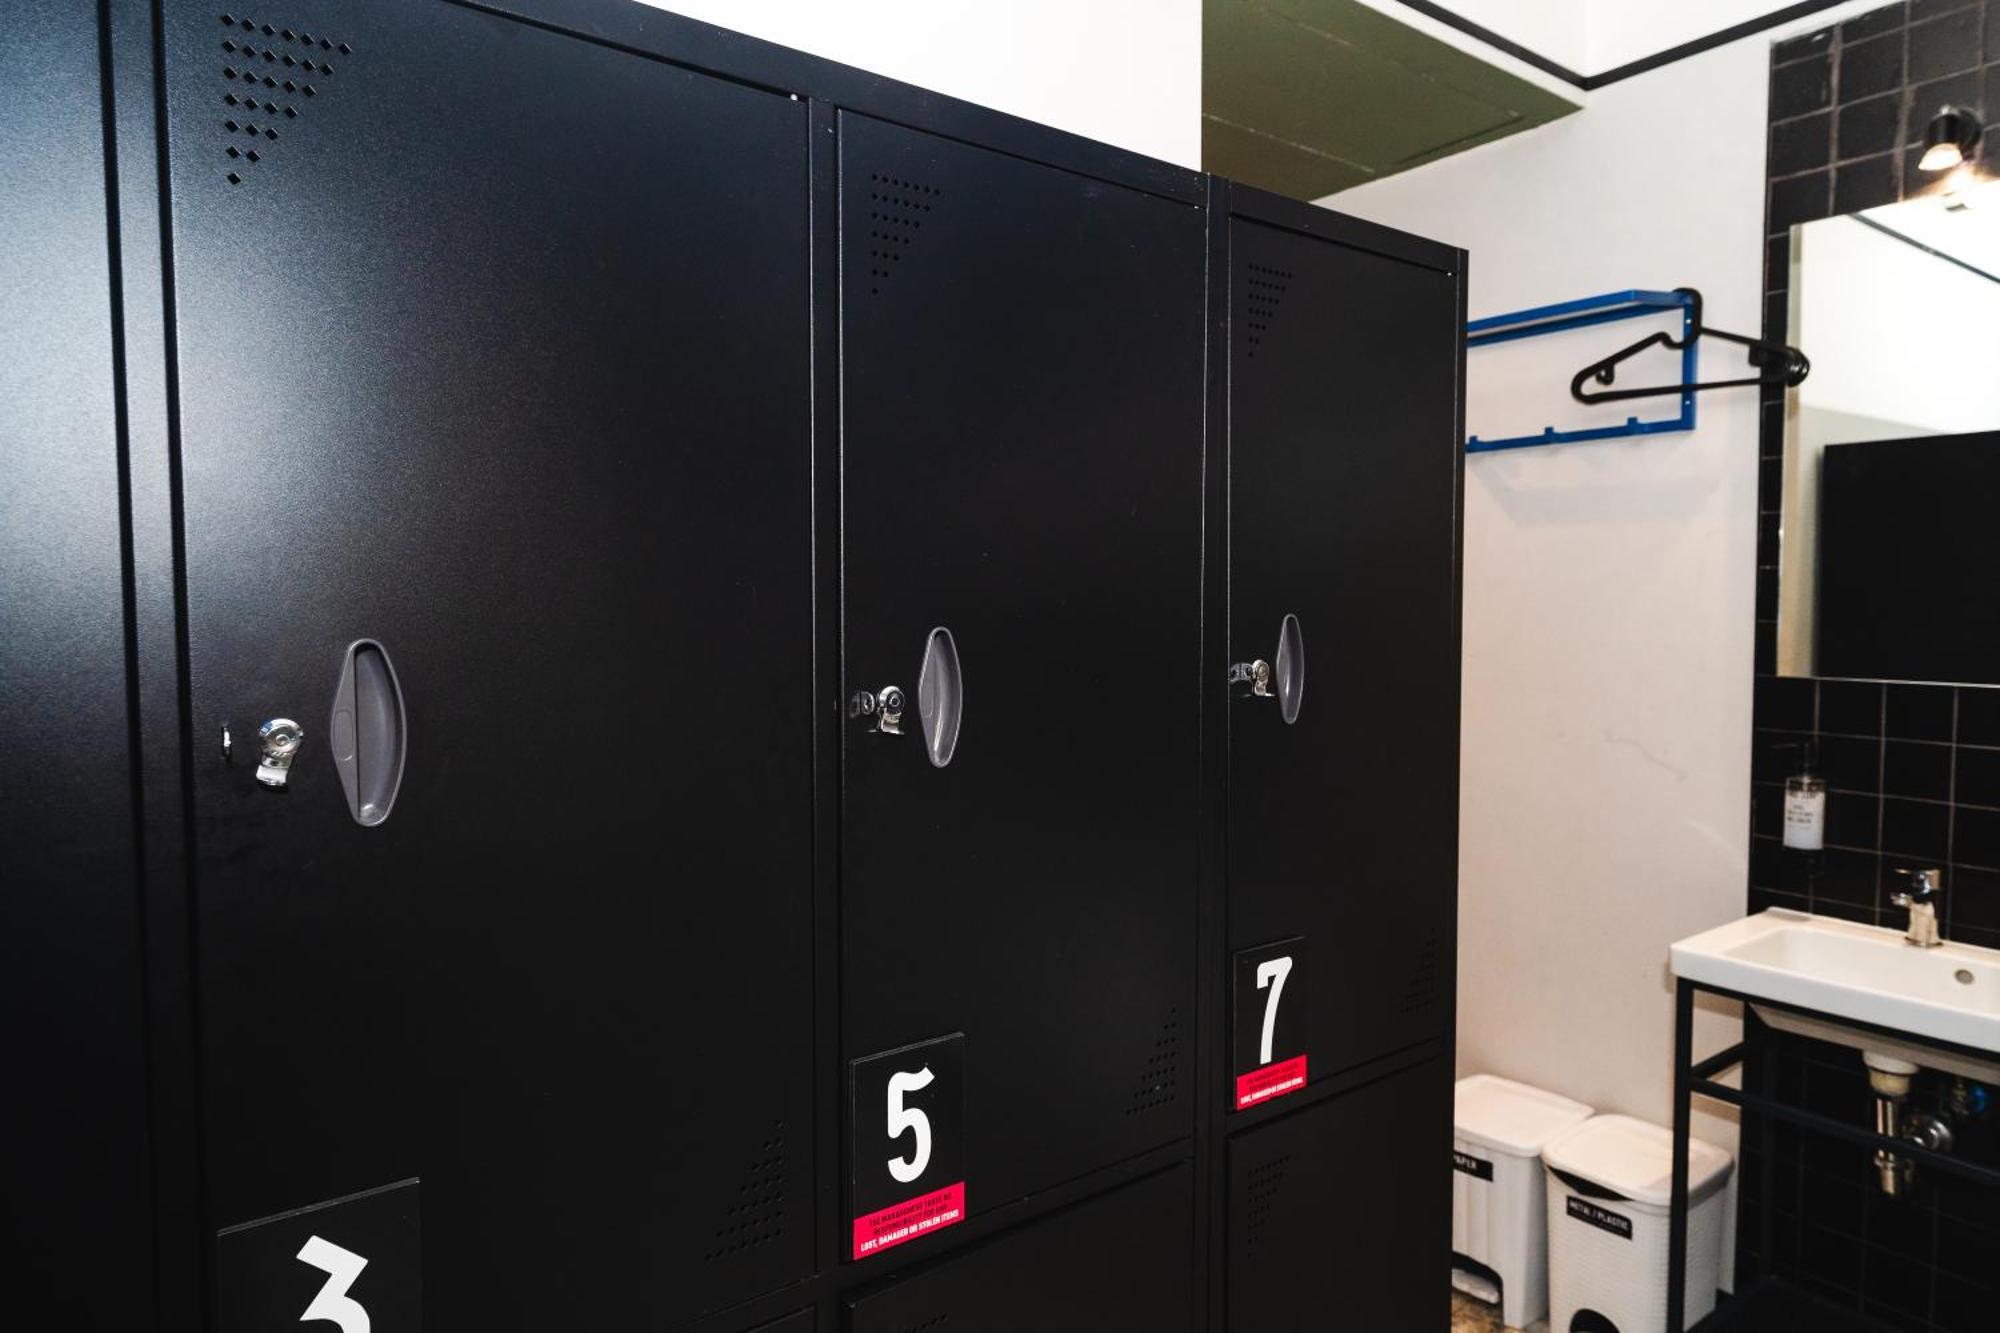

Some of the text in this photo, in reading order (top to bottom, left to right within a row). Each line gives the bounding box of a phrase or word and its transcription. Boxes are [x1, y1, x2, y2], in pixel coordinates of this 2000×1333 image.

[1257, 956, 1293, 1065] 7
[887, 1066, 935, 1183] 5
[861, 1208, 959, 1252] LOST, DAMAGED OR STOLEN ITEMS
[1598, 1212, 1628, 1230] PLASTIC
